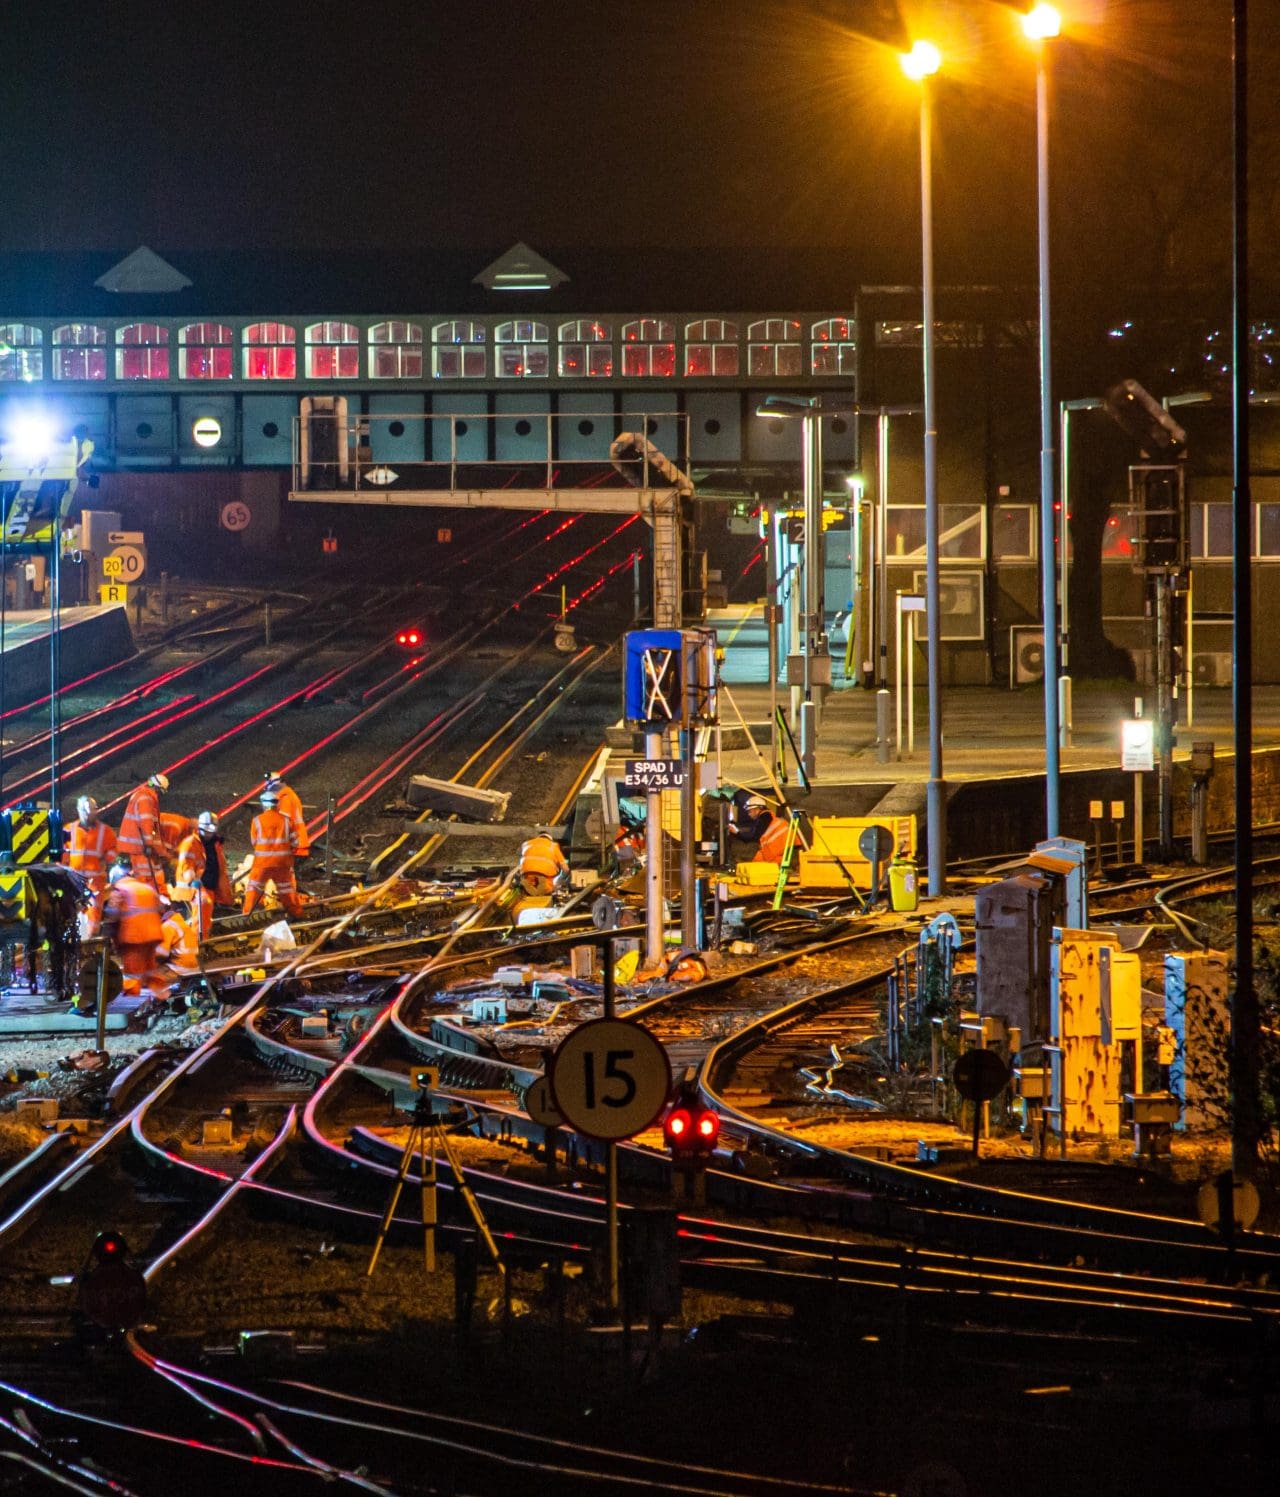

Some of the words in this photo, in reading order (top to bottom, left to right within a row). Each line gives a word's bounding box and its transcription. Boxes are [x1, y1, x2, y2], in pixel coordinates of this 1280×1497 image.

[227, 508, 246, 525] 65
[793, 523, 805, 542] 2
[105, 561, 120, 573] 20
[109, 587, 119, 601] R
[634, 762, 666, 773] SPAD
[625, 774, 669, 786] E34/36
[584, 1051, 636, 1108] 15
